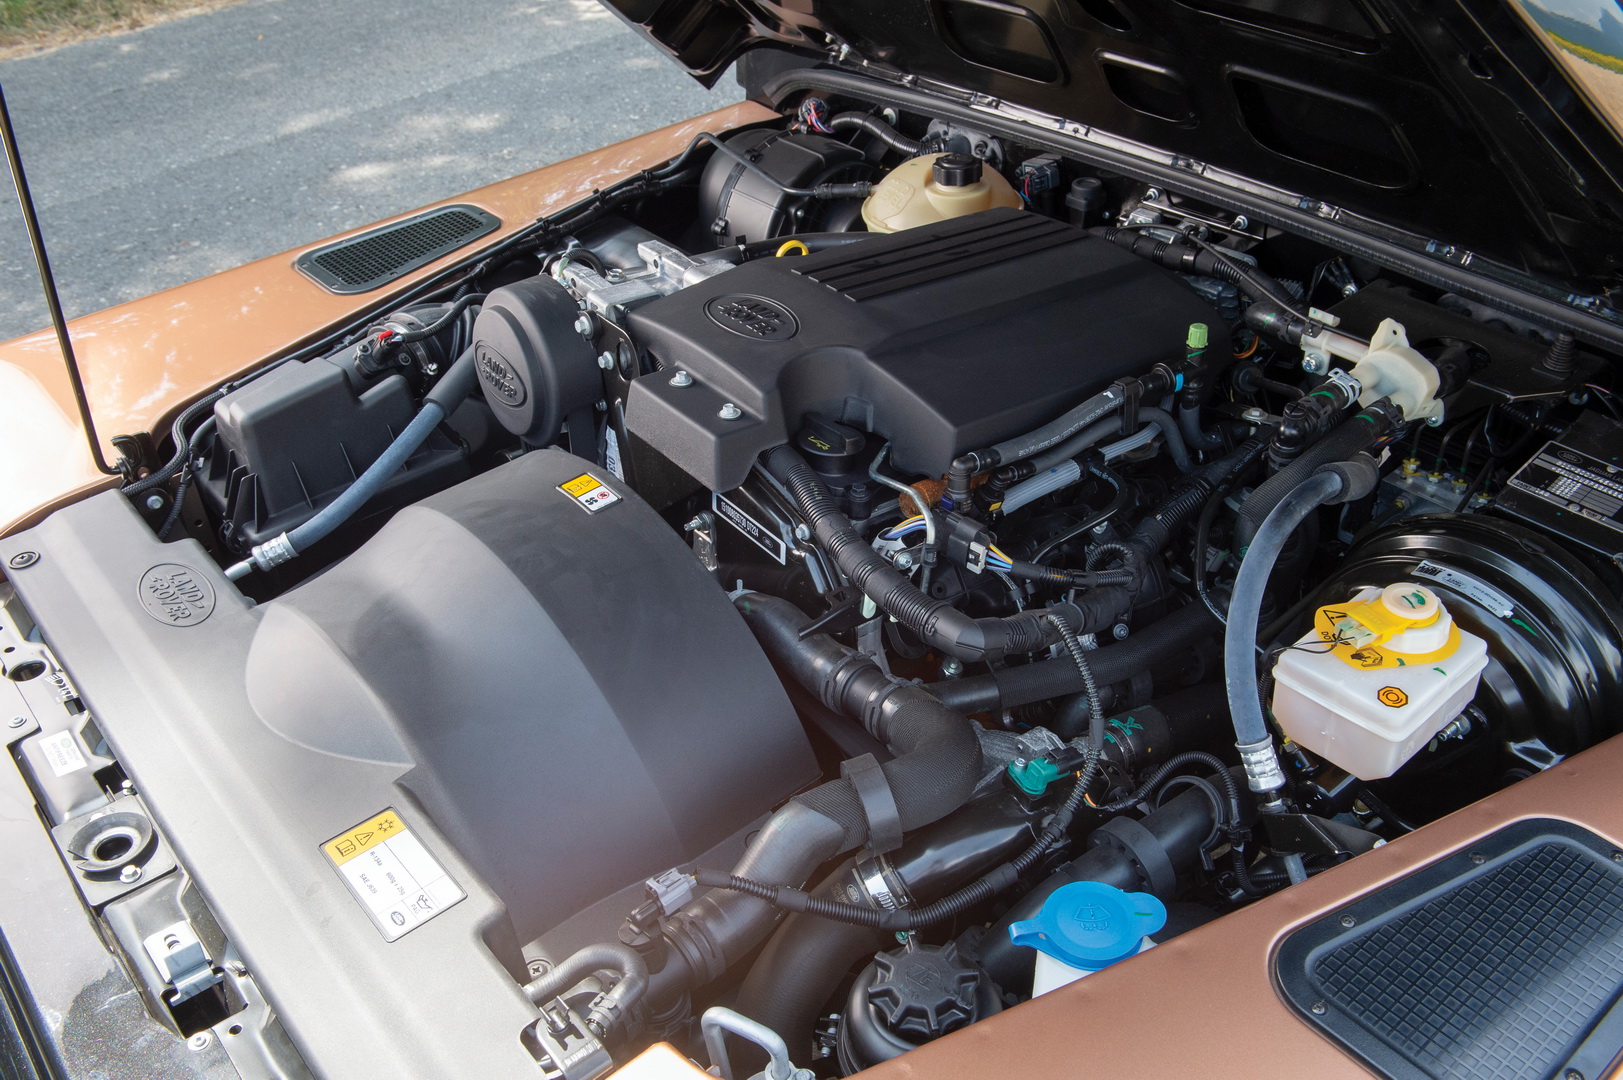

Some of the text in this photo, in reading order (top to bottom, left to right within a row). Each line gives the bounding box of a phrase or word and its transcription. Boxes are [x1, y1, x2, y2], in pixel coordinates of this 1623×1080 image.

[482, 351, 507, 379] LAND
[485, 369, 517, 400] ROVER
[147, 578, 192, 622] ROVER
[166, 571, 204, 602] LAND
[370, 850, 383, 867] R-134a
[359, 872, 370, 884] SAE
